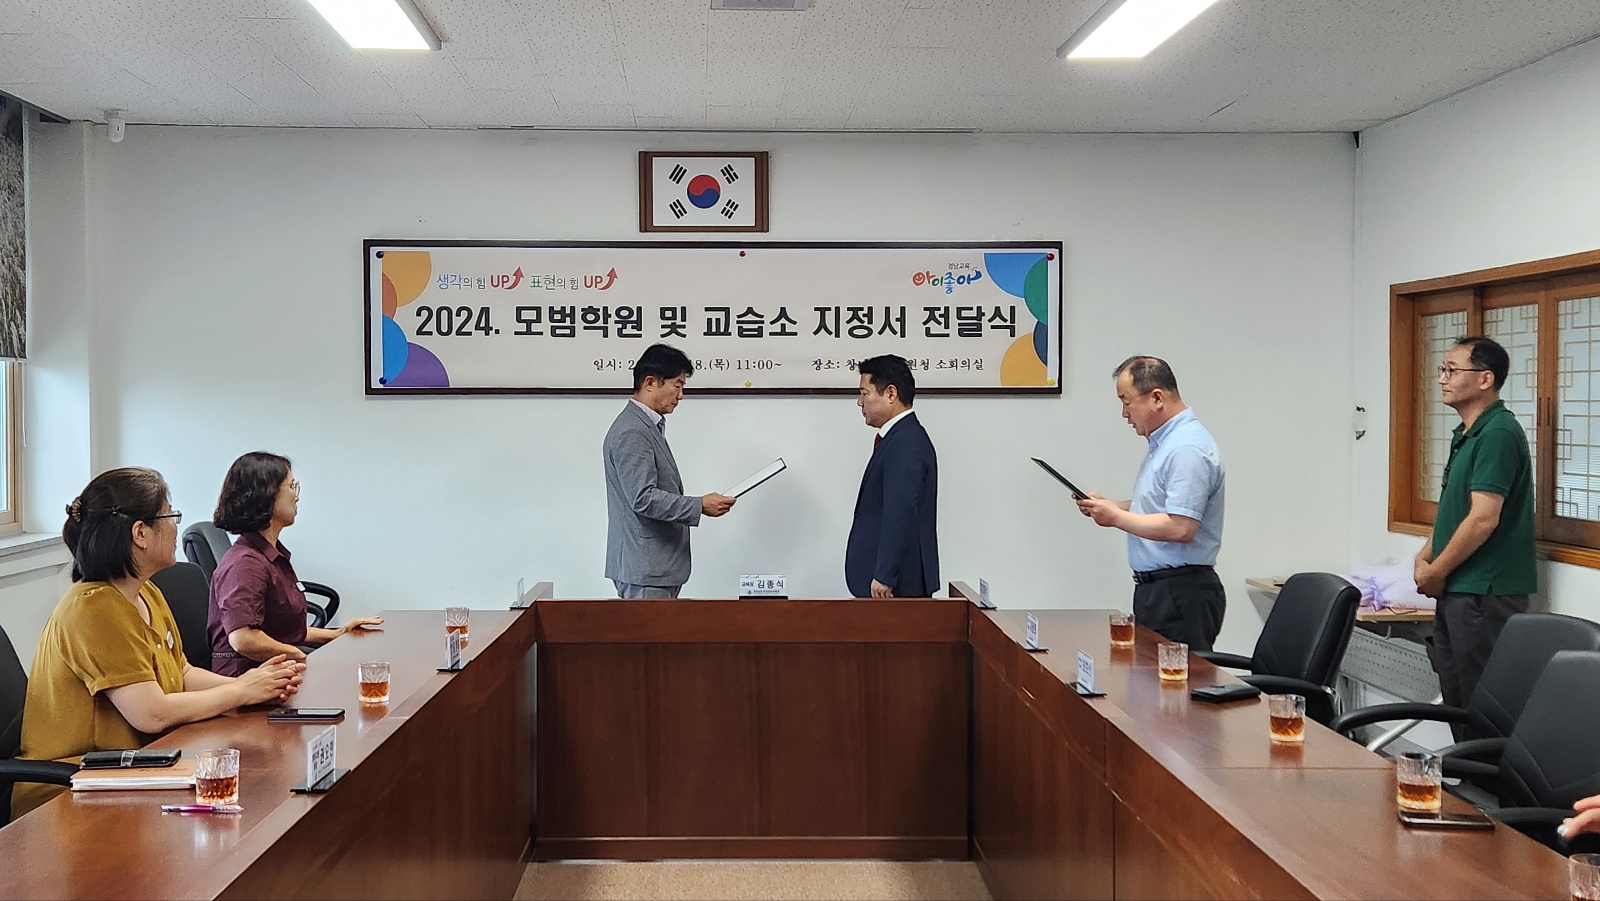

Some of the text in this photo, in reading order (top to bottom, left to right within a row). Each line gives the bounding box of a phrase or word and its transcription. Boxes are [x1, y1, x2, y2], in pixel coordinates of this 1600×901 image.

[947, 262, 970, 271] 경남교육
[436, 273, 604, 291] 생각의 힘 UP 표현의 힘 UP
[912, 269, 983, 295] 아이좋아
[415, 305, 1017, 339] 2024. 모범학원 및 교습소 지정서 전달식
[593, 358, 622, 371] 일시:
[736, 359, 783, 371] 11:00~
[811, 358, 840, 371] 장소:
[935, 358, 984, 371] 소회의실
